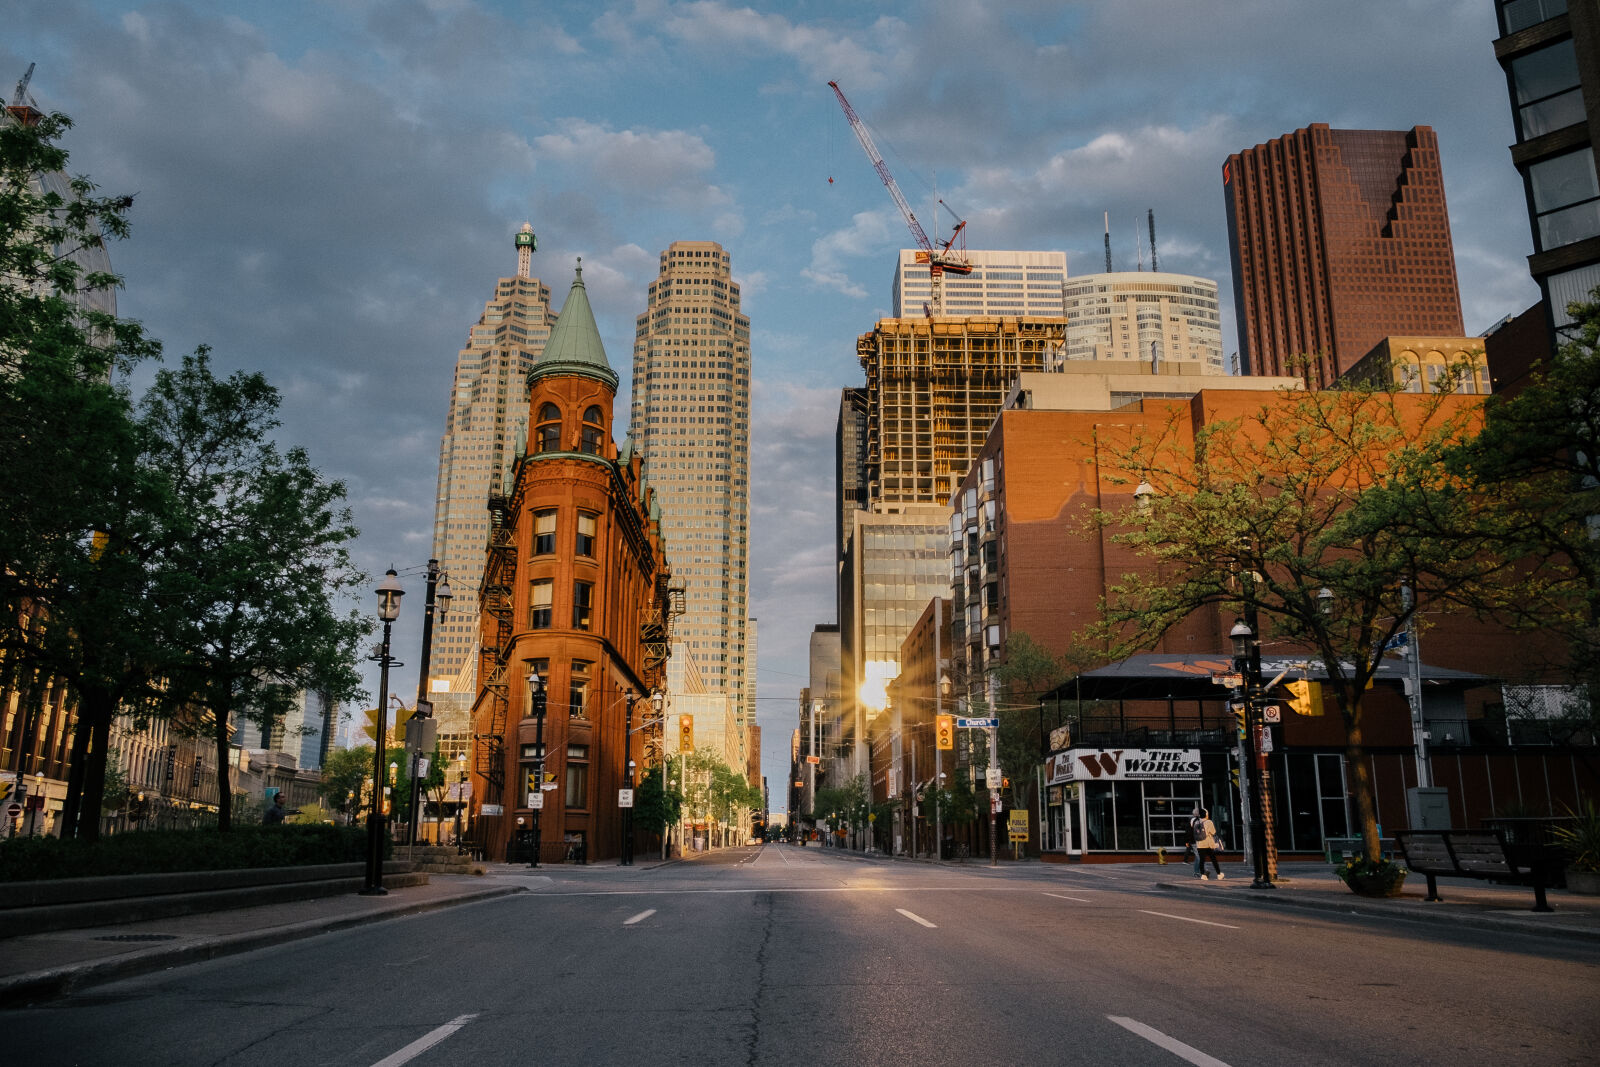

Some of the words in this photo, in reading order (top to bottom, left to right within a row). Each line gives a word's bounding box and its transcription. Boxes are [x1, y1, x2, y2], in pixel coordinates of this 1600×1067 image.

[519, 234, 530, 243] TD
[965, 718, 987, 726] Church
[1149, 751, 1182, 761] THE
[1078, 750, 1124, 777] W
[1125, 758, 1201, 773] WORKS
